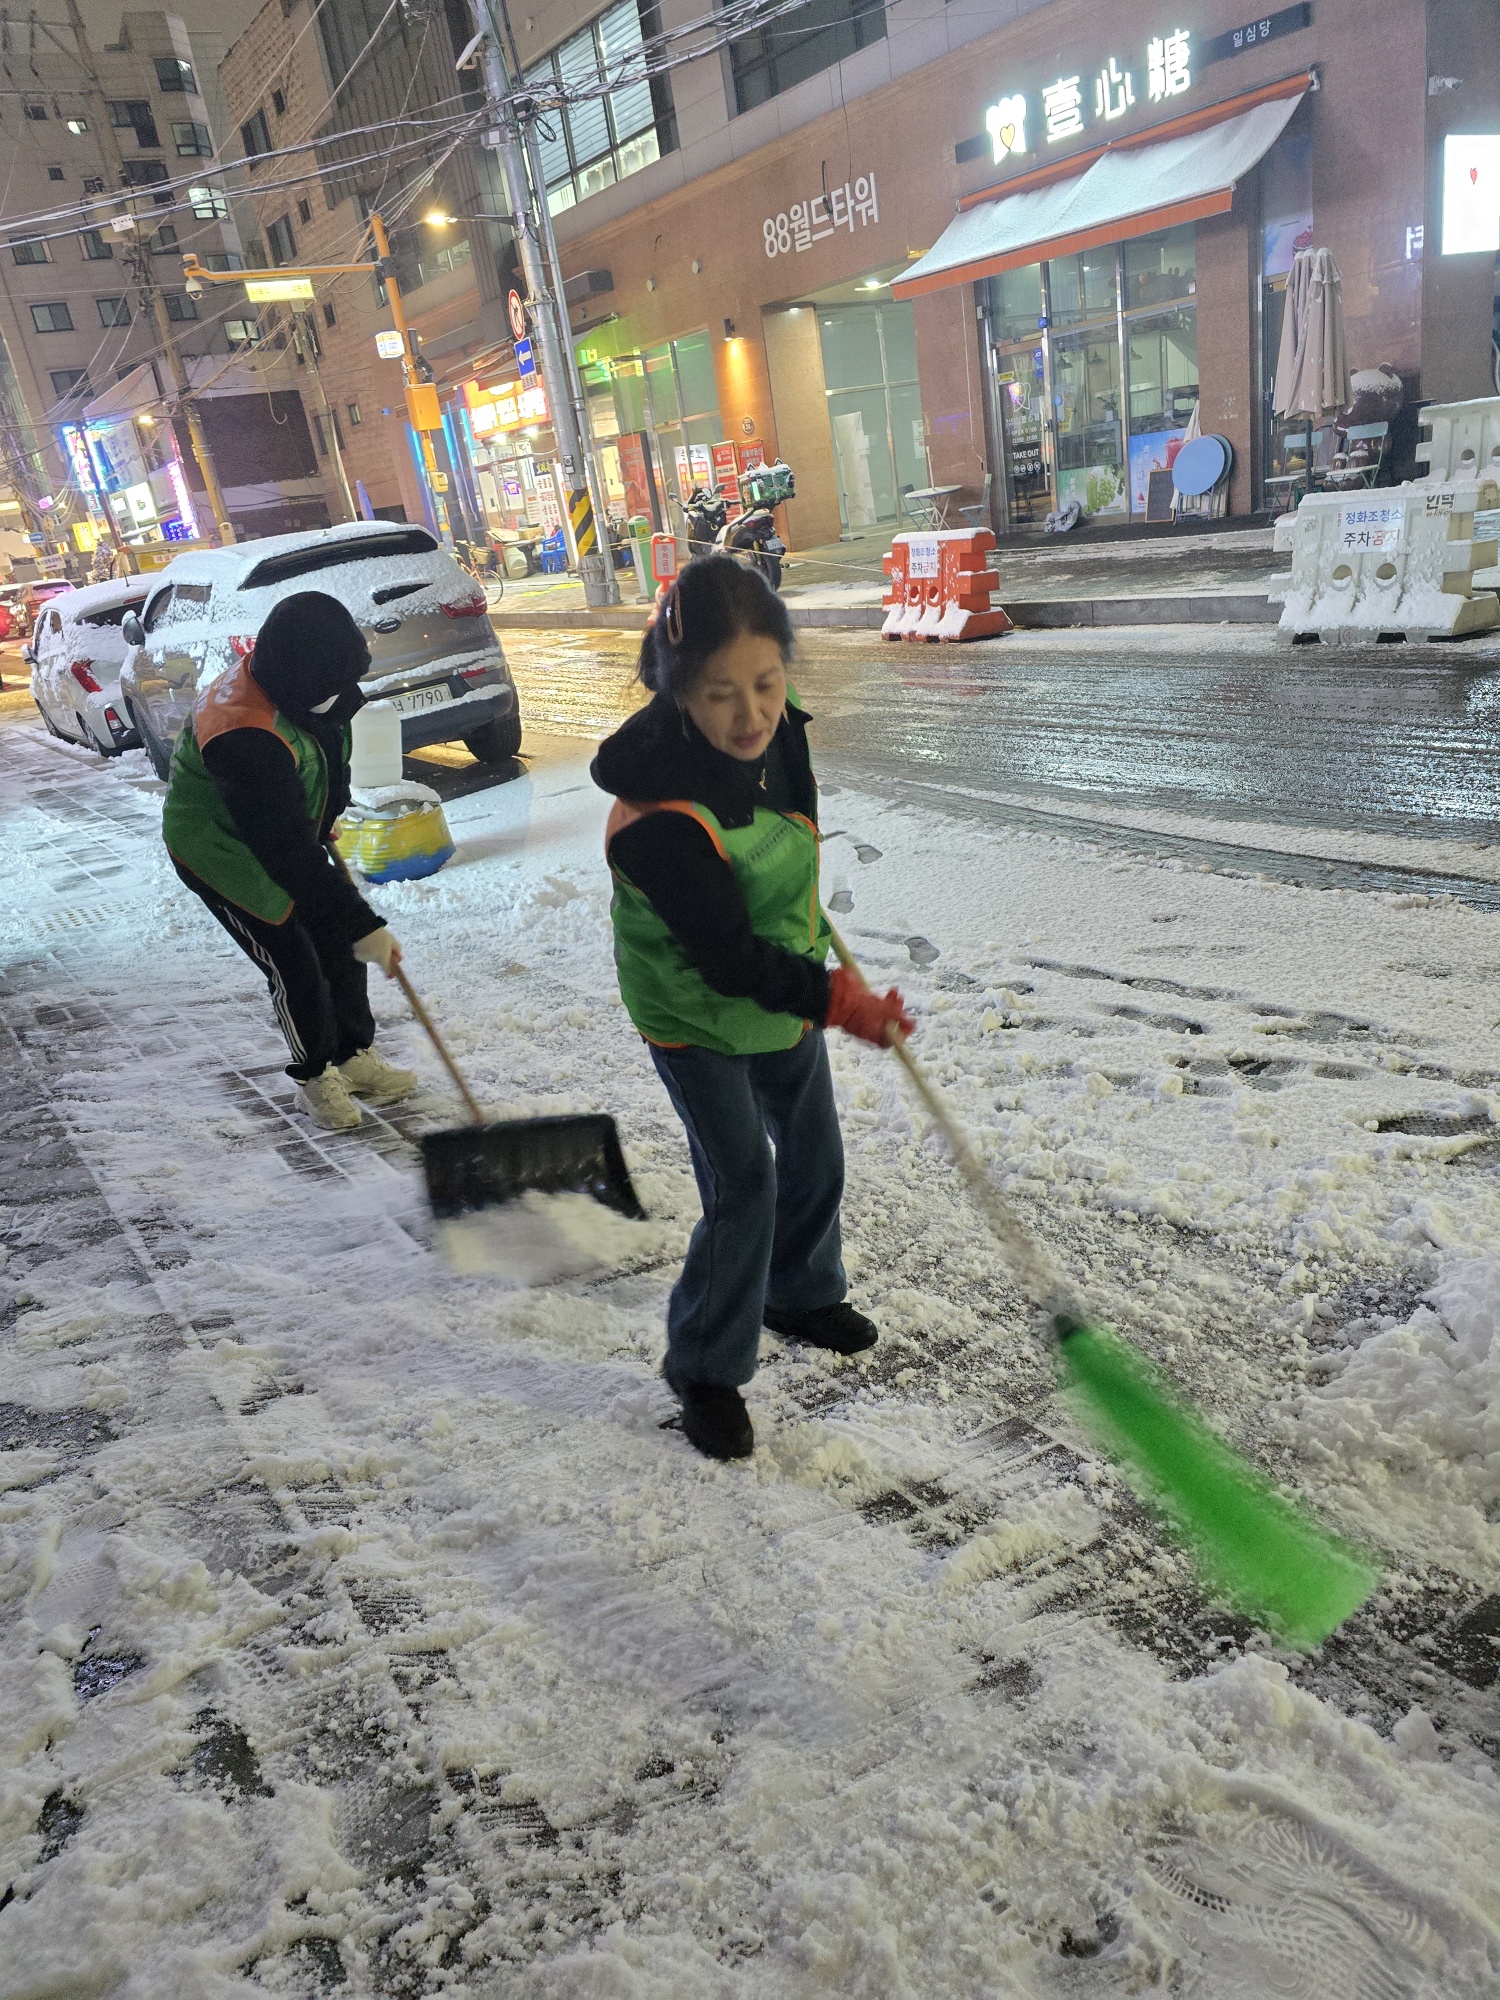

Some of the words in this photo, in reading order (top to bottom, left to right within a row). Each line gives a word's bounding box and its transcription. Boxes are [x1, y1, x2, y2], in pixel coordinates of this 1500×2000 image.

[1233, 20, 1271, 48] 일심당
[1042, 28, 1191, 144] 壹心糖
[763, 172, 879, 258] 88월드타워
[1012, 450, 1027, 460] TAKE
[1027, 448, 1039, 457] OUT
[1345, 508, 1404, 525] 정화조청소
[661, 545, 669, 573] 주차금지
[911, 547, 936, 557] 정화조청소
[911, 561, 937, 574] 주차금지
[408, 689, 444, 709] 7790
